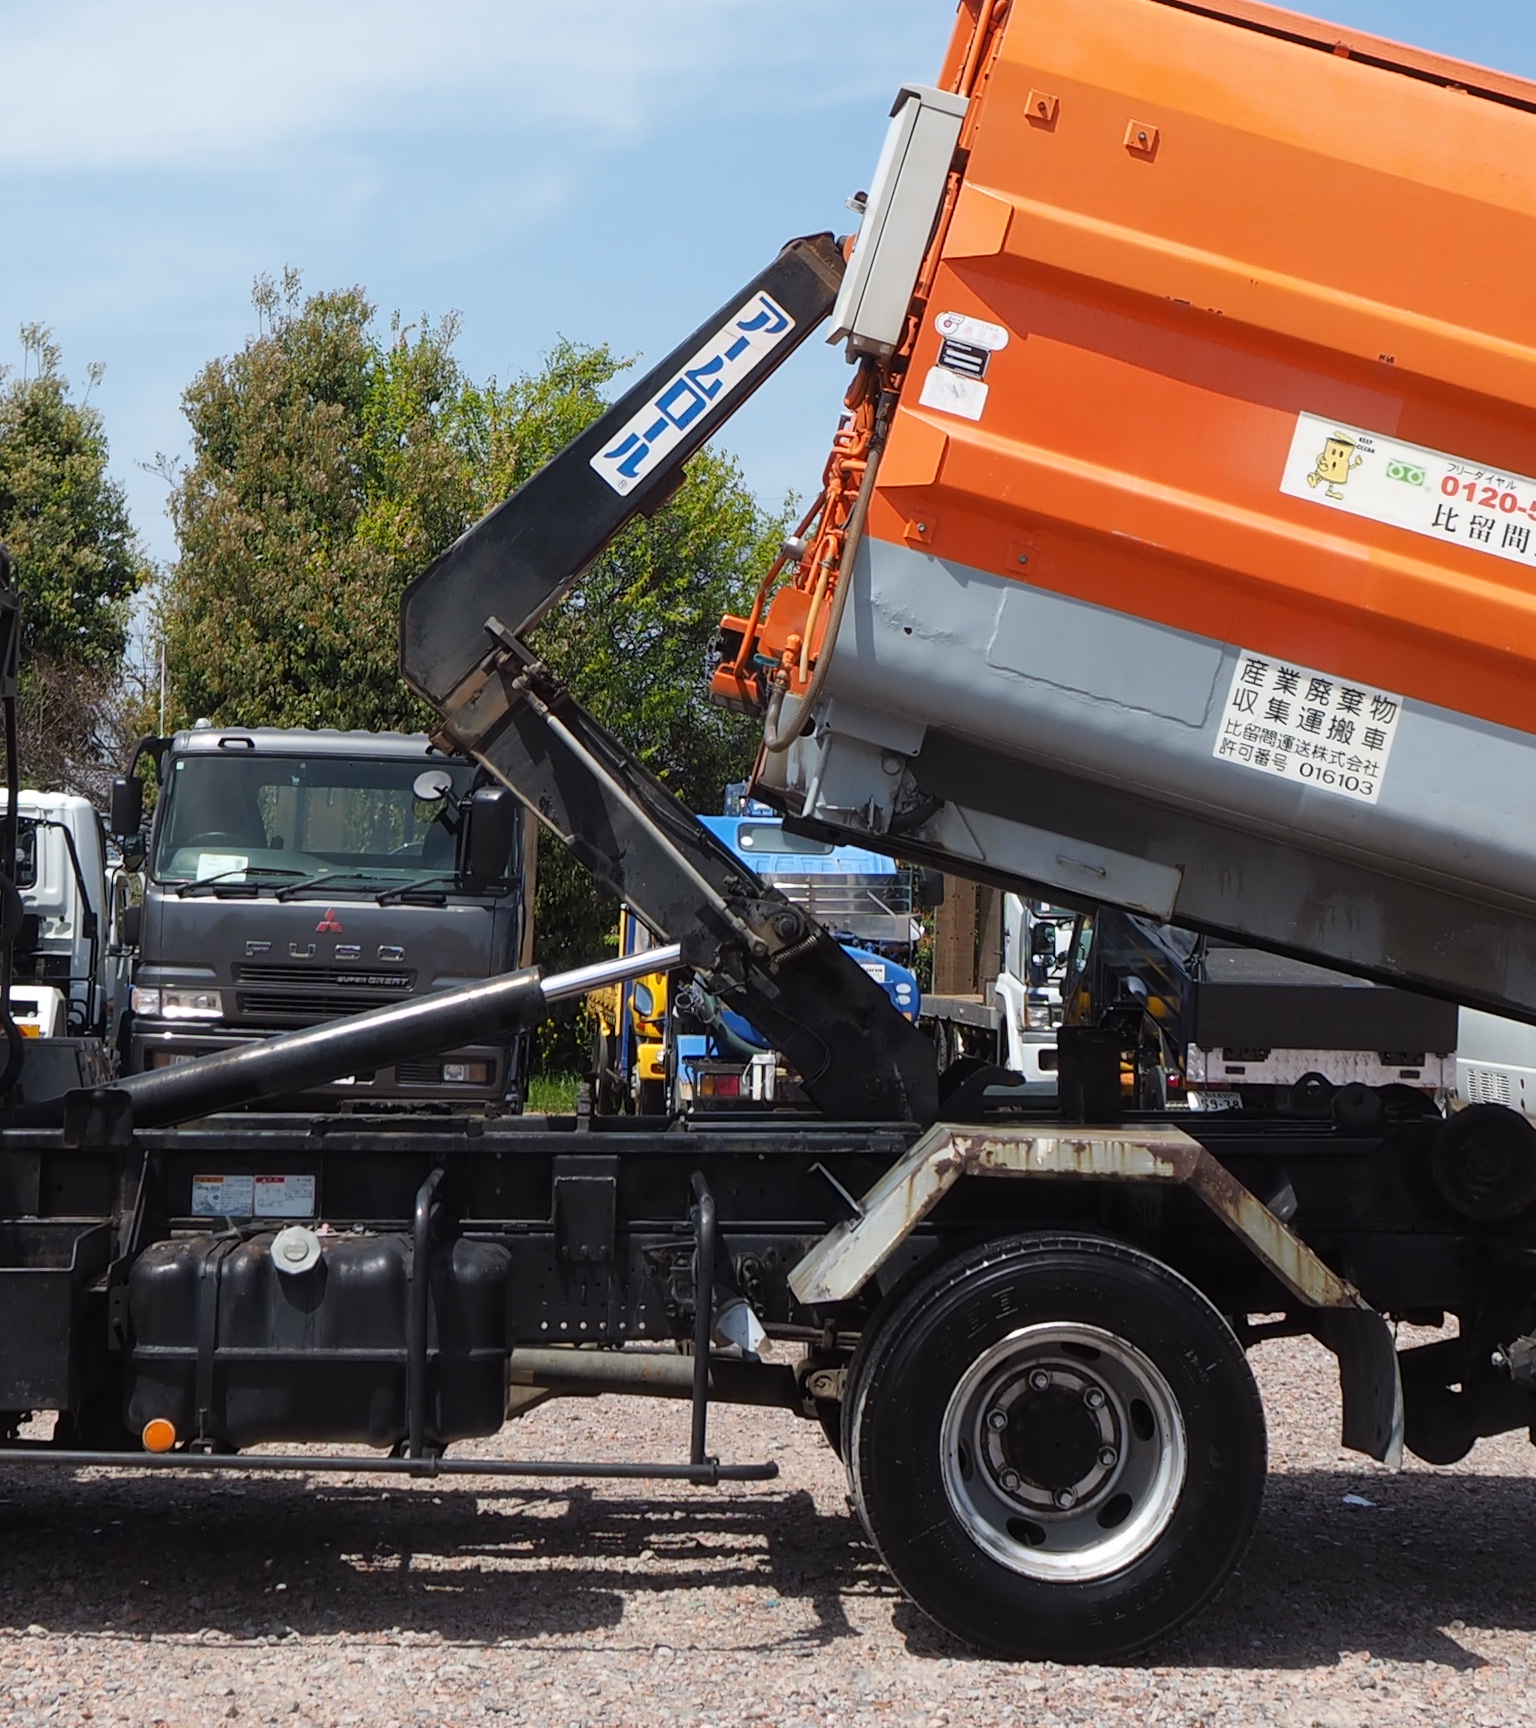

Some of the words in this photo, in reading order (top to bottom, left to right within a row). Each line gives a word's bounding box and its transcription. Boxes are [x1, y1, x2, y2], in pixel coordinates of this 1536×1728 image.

[603, 296, 789, 478] アームロール
[1447, 462, 1517, 490] フリーダイヤル
[1232, 687, 1388, 752] 収集運搬車
[1240, 658, 1398, 725] 産業廃棄物
[1219, 737, 1288, 773] 許可番号
[1299, 762, 1374, 796] 016103
[1223, 718, 1381, 779] 比留間運送株式会社
[245, 940, 406, 962] FUSO
